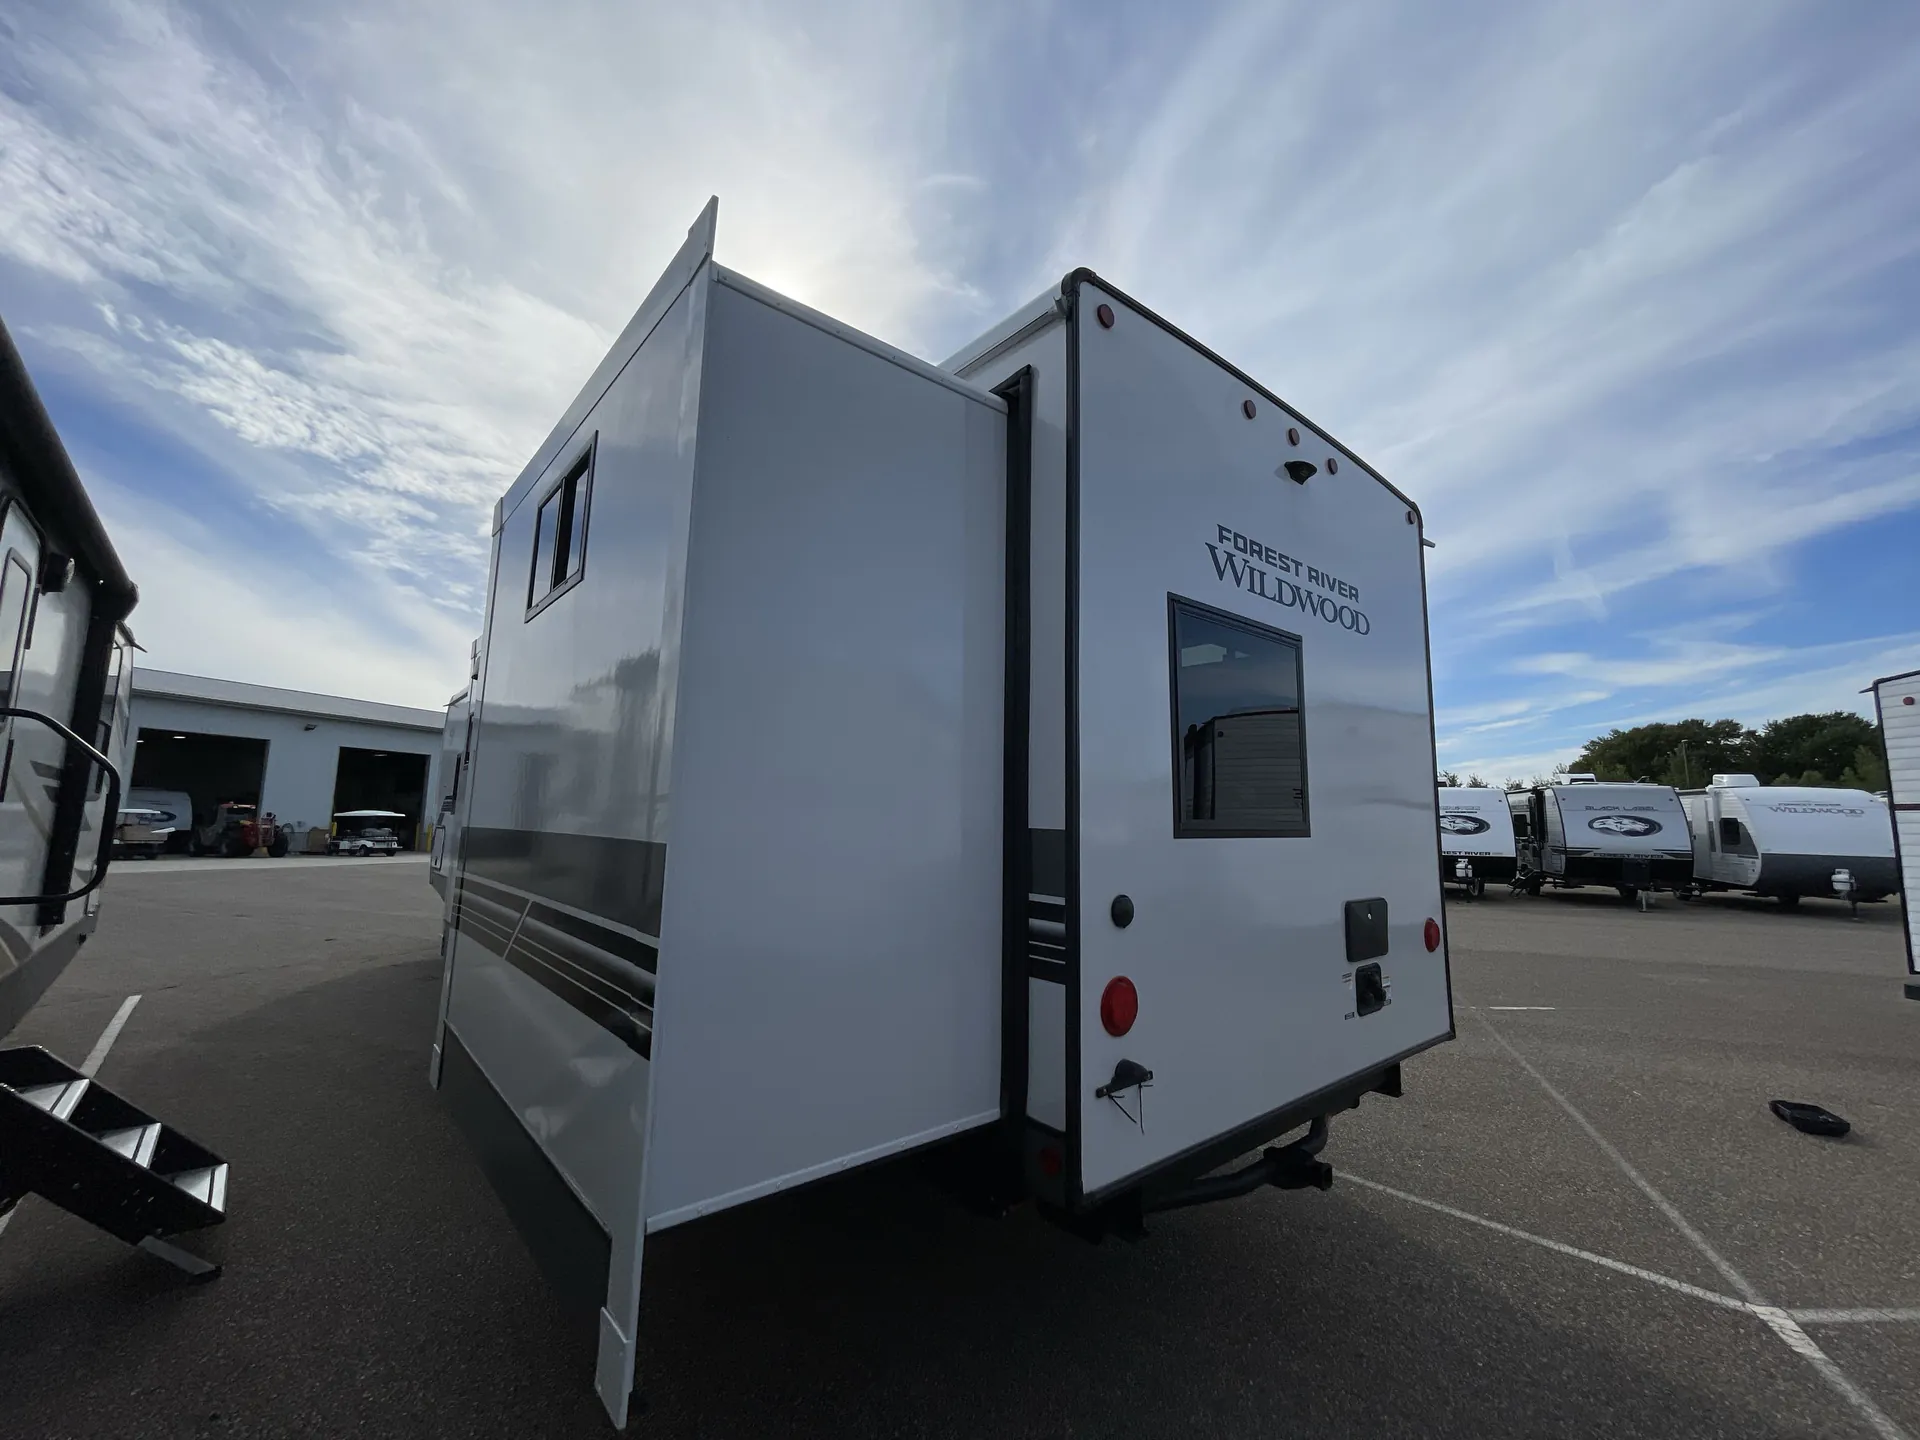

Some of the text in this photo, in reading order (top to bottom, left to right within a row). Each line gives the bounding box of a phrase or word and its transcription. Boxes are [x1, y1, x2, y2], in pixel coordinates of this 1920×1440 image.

[1205, 542, 1371, 636] WILDWOOD
[1217, 524, 1359, 603] FOREST RIVER
[1768, 806, 1865, 815] WILDWOOD
